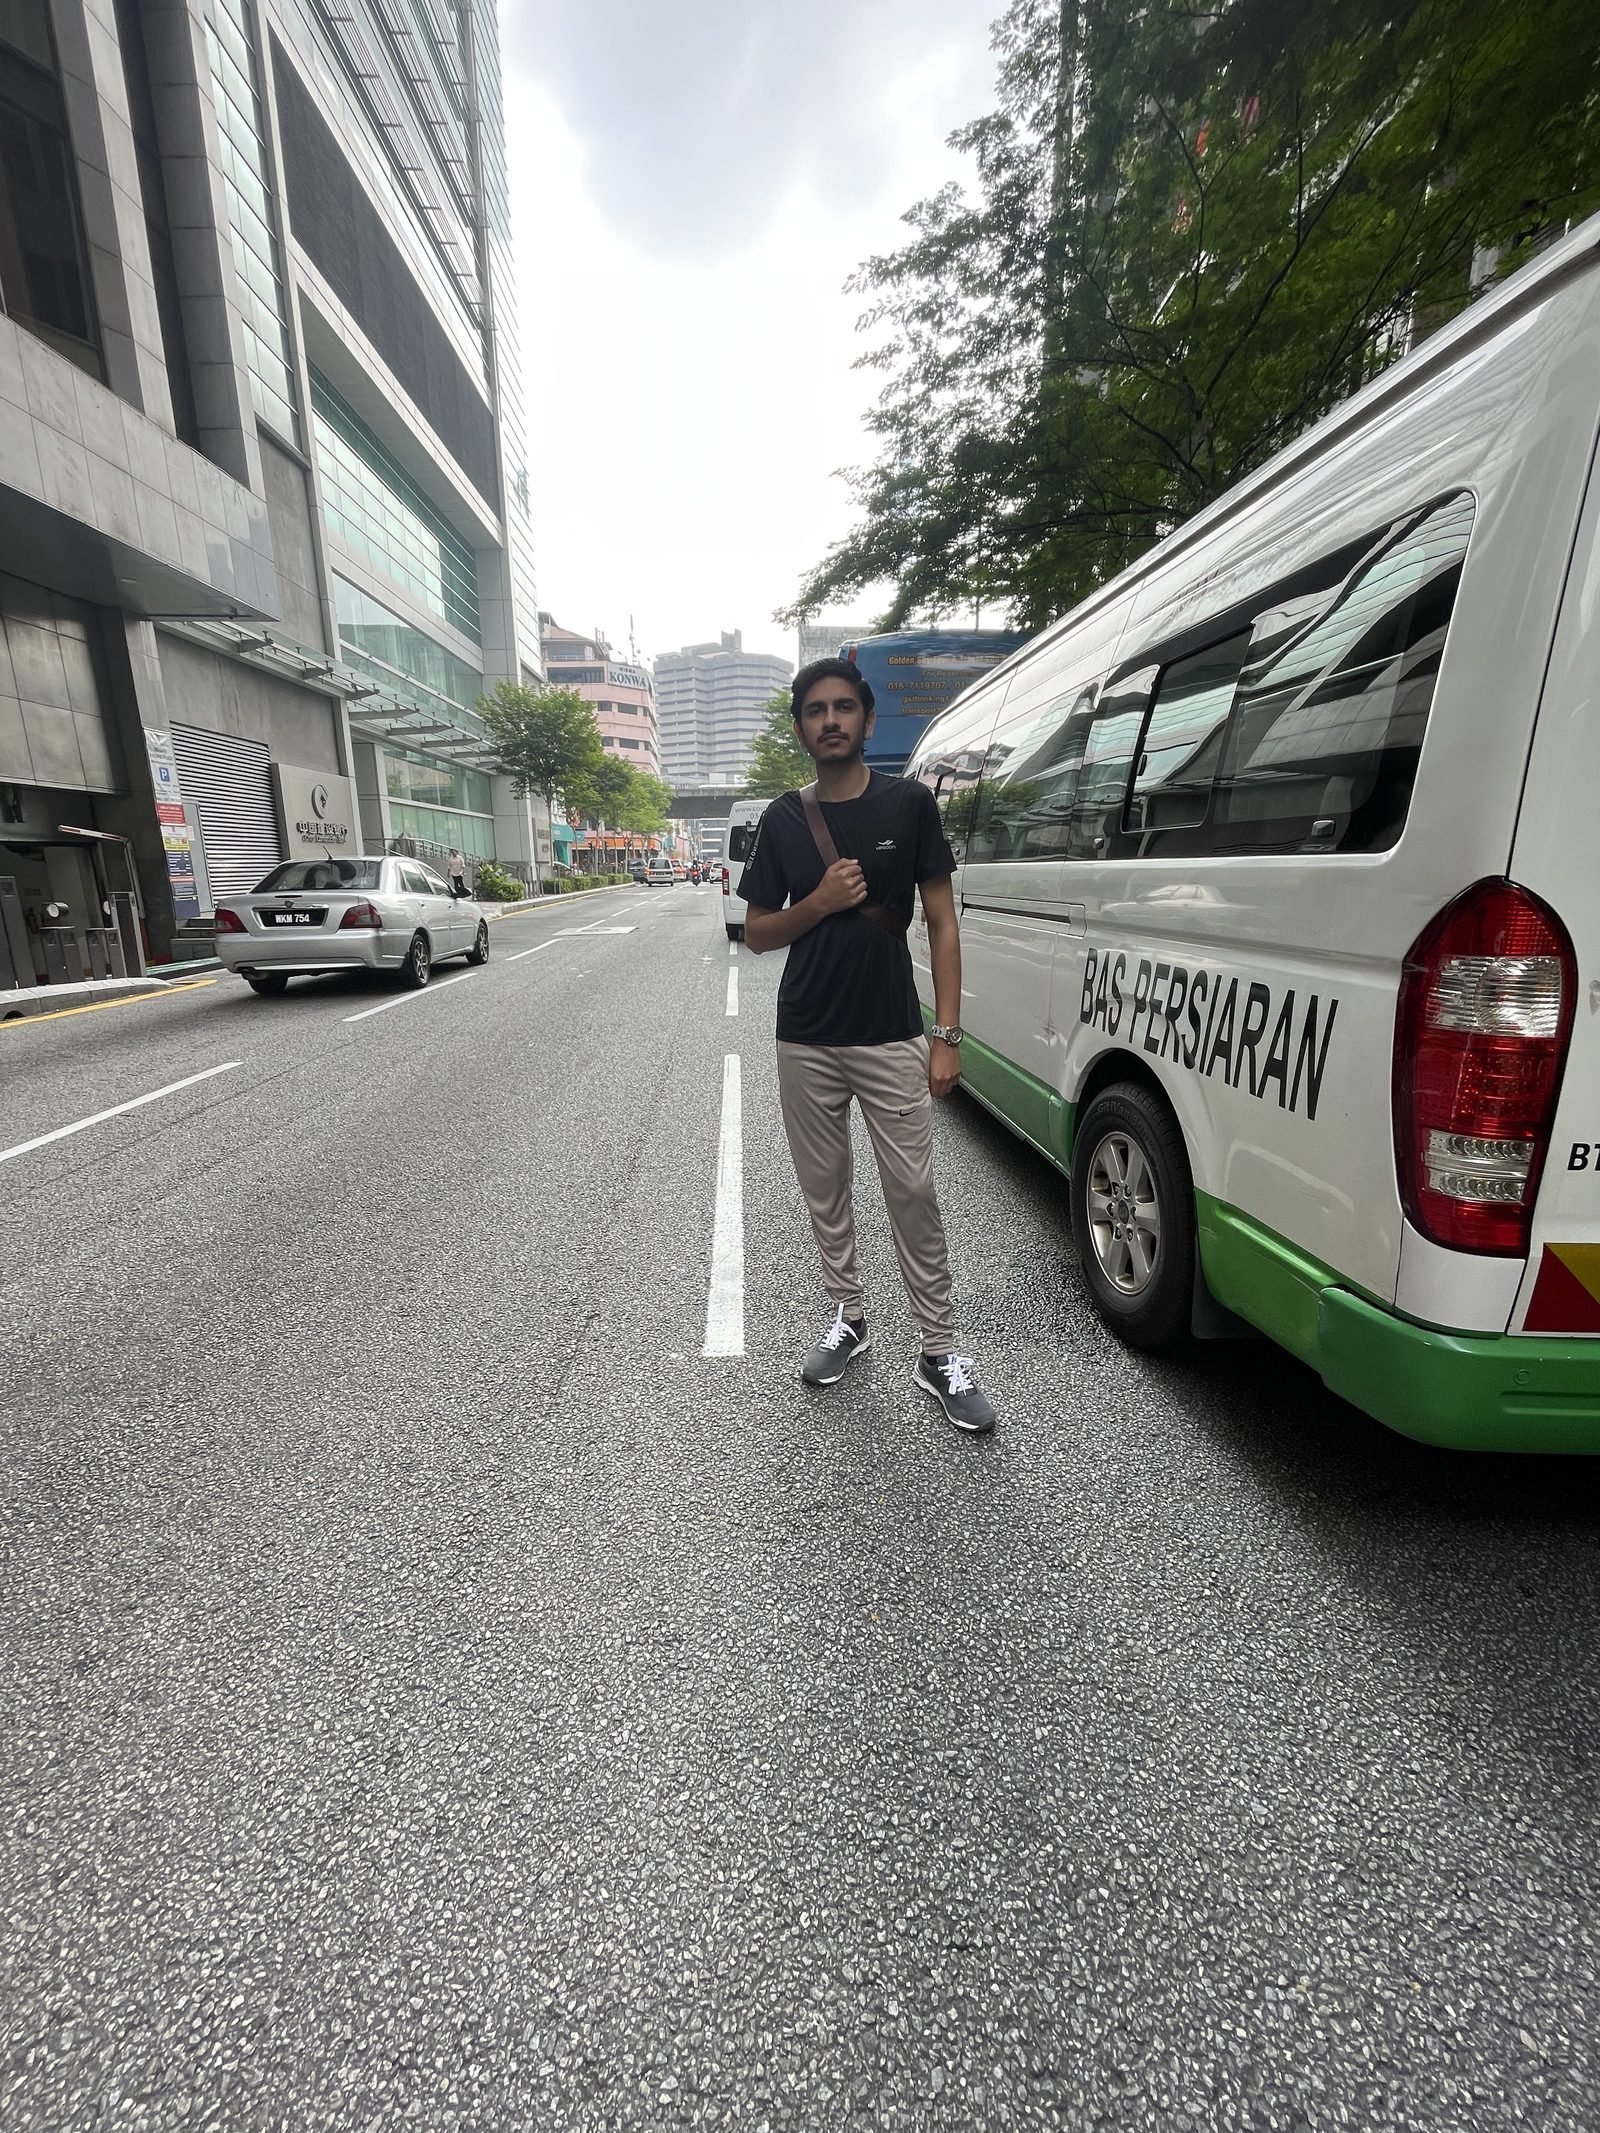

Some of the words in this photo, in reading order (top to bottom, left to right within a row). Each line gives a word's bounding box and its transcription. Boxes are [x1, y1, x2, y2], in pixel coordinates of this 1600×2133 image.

[888, 655, 915, 666] Golden
[609, 671, 647, 687] KONWA
[275, 914, 293, 923] WKM
[294, 913, 310, 923] 754
[1080, 947, 1127, 1037] BAS
[1128, 959, 1339, 1121] PERSIARAN
